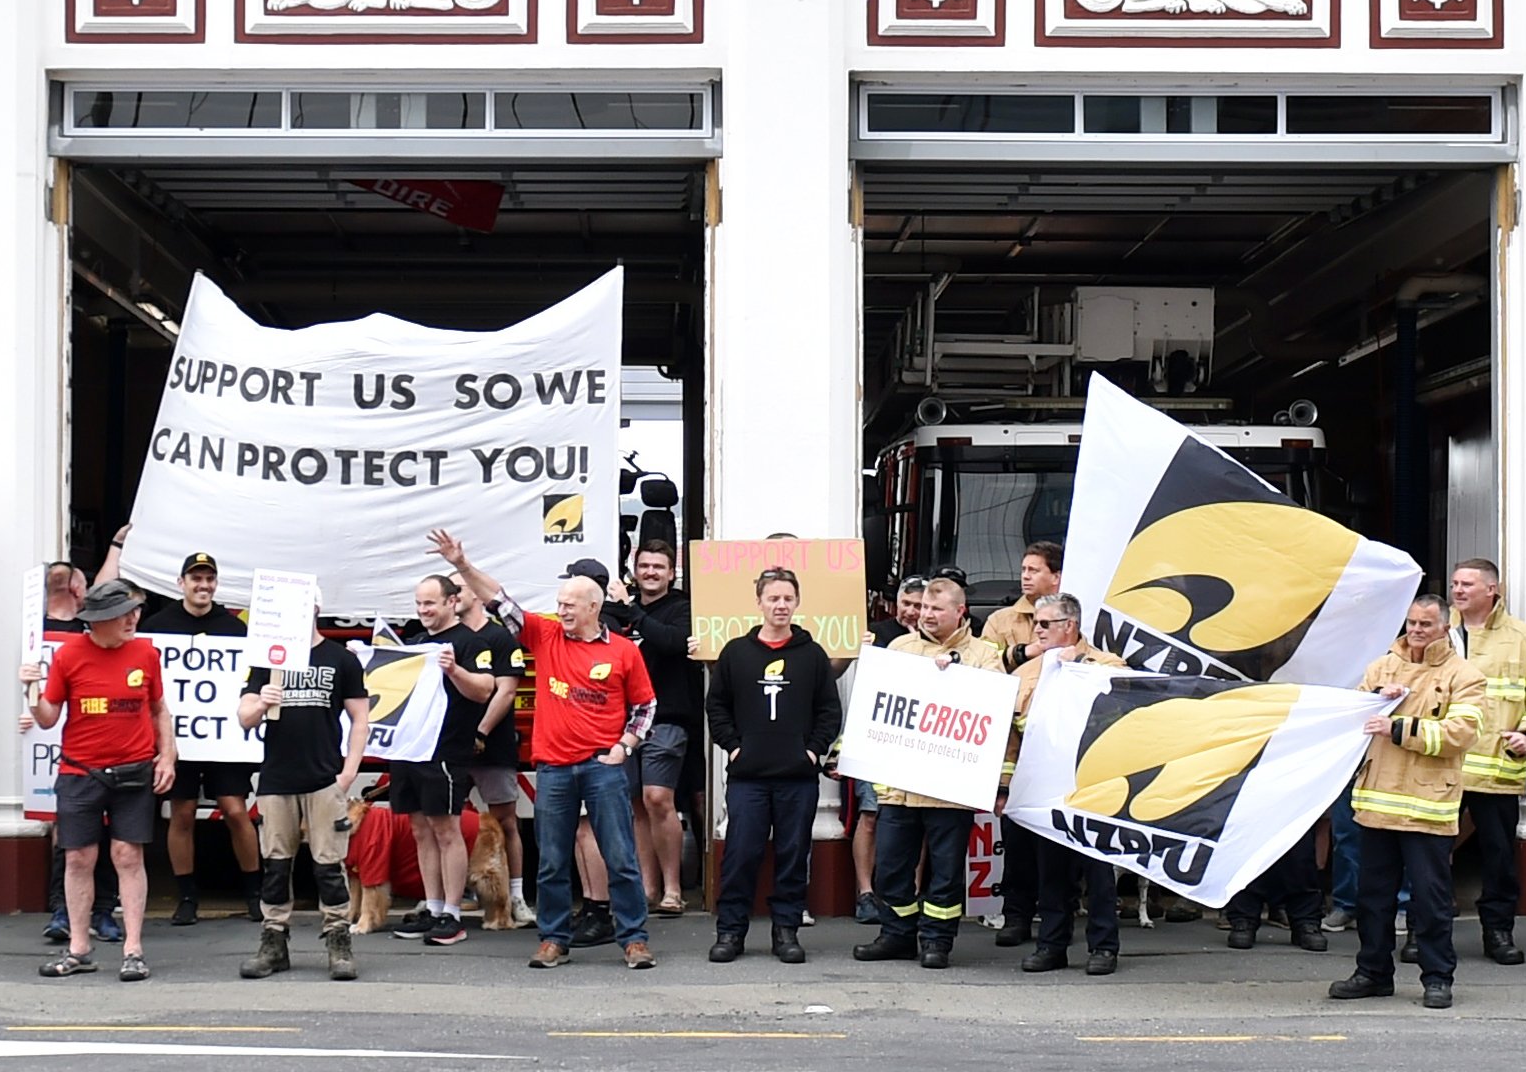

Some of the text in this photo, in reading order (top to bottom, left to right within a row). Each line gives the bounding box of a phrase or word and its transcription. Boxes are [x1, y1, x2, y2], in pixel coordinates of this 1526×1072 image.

[373, 178, 454, 217] DIRE
[169, 356, 322, 407] SUPPORT
[354, 373, 415, 410] US
[151, 427, 589, 487] CAN PROTECT YOU!
[697, 541, 862, 574] SUPPORT US
[813, 615, 859, 652] YOU
[174, 679, 217, 703] TO
[872, 692, 991, 745] FIRE CRISIS
[867, 728, 979, 764] support us to protect you
